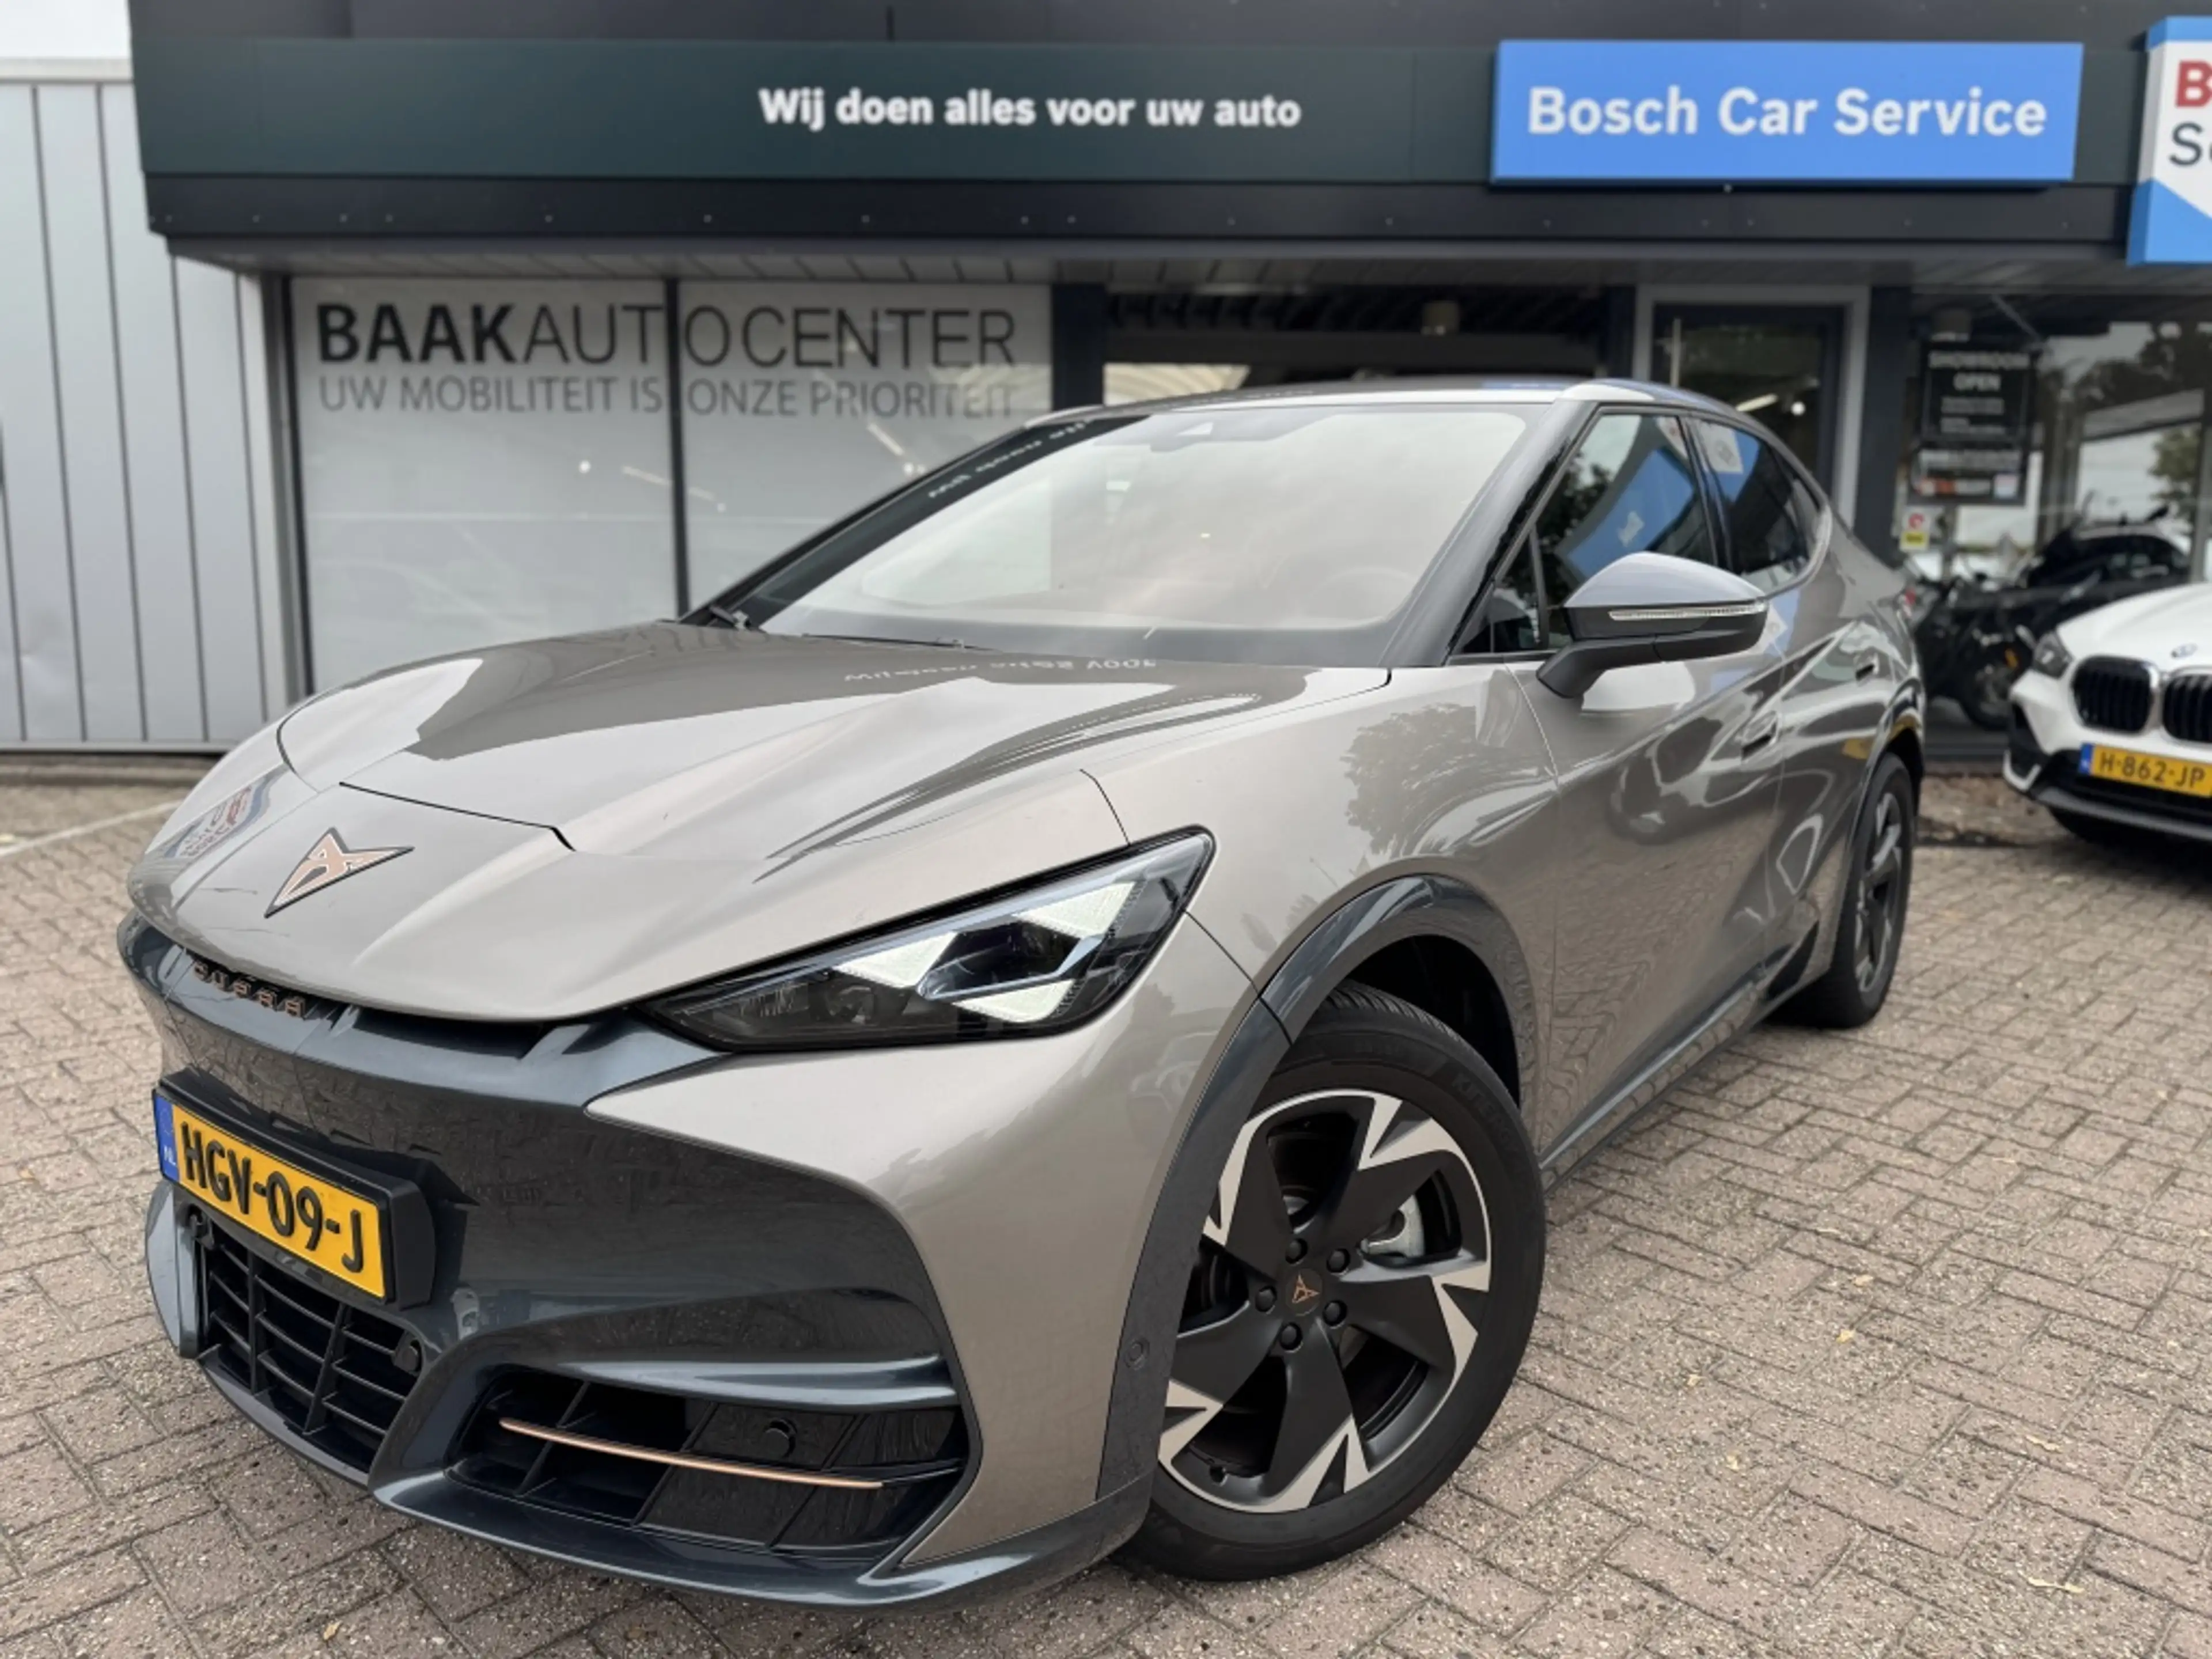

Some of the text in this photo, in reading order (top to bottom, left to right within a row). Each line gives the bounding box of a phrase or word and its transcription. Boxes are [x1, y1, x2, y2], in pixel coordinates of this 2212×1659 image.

[759, 89, 1302, 131] Wij doen alles voor uw auto
[1528, 85, 2047, 137] Bosch Car Service
[2169, 120, 2212, 167] S
[319, 375, 1018, 419] UW MOBILITEIT IS ONZE PRIORITEIT
[181, 1120, 364, 1273] HGV-09-J
